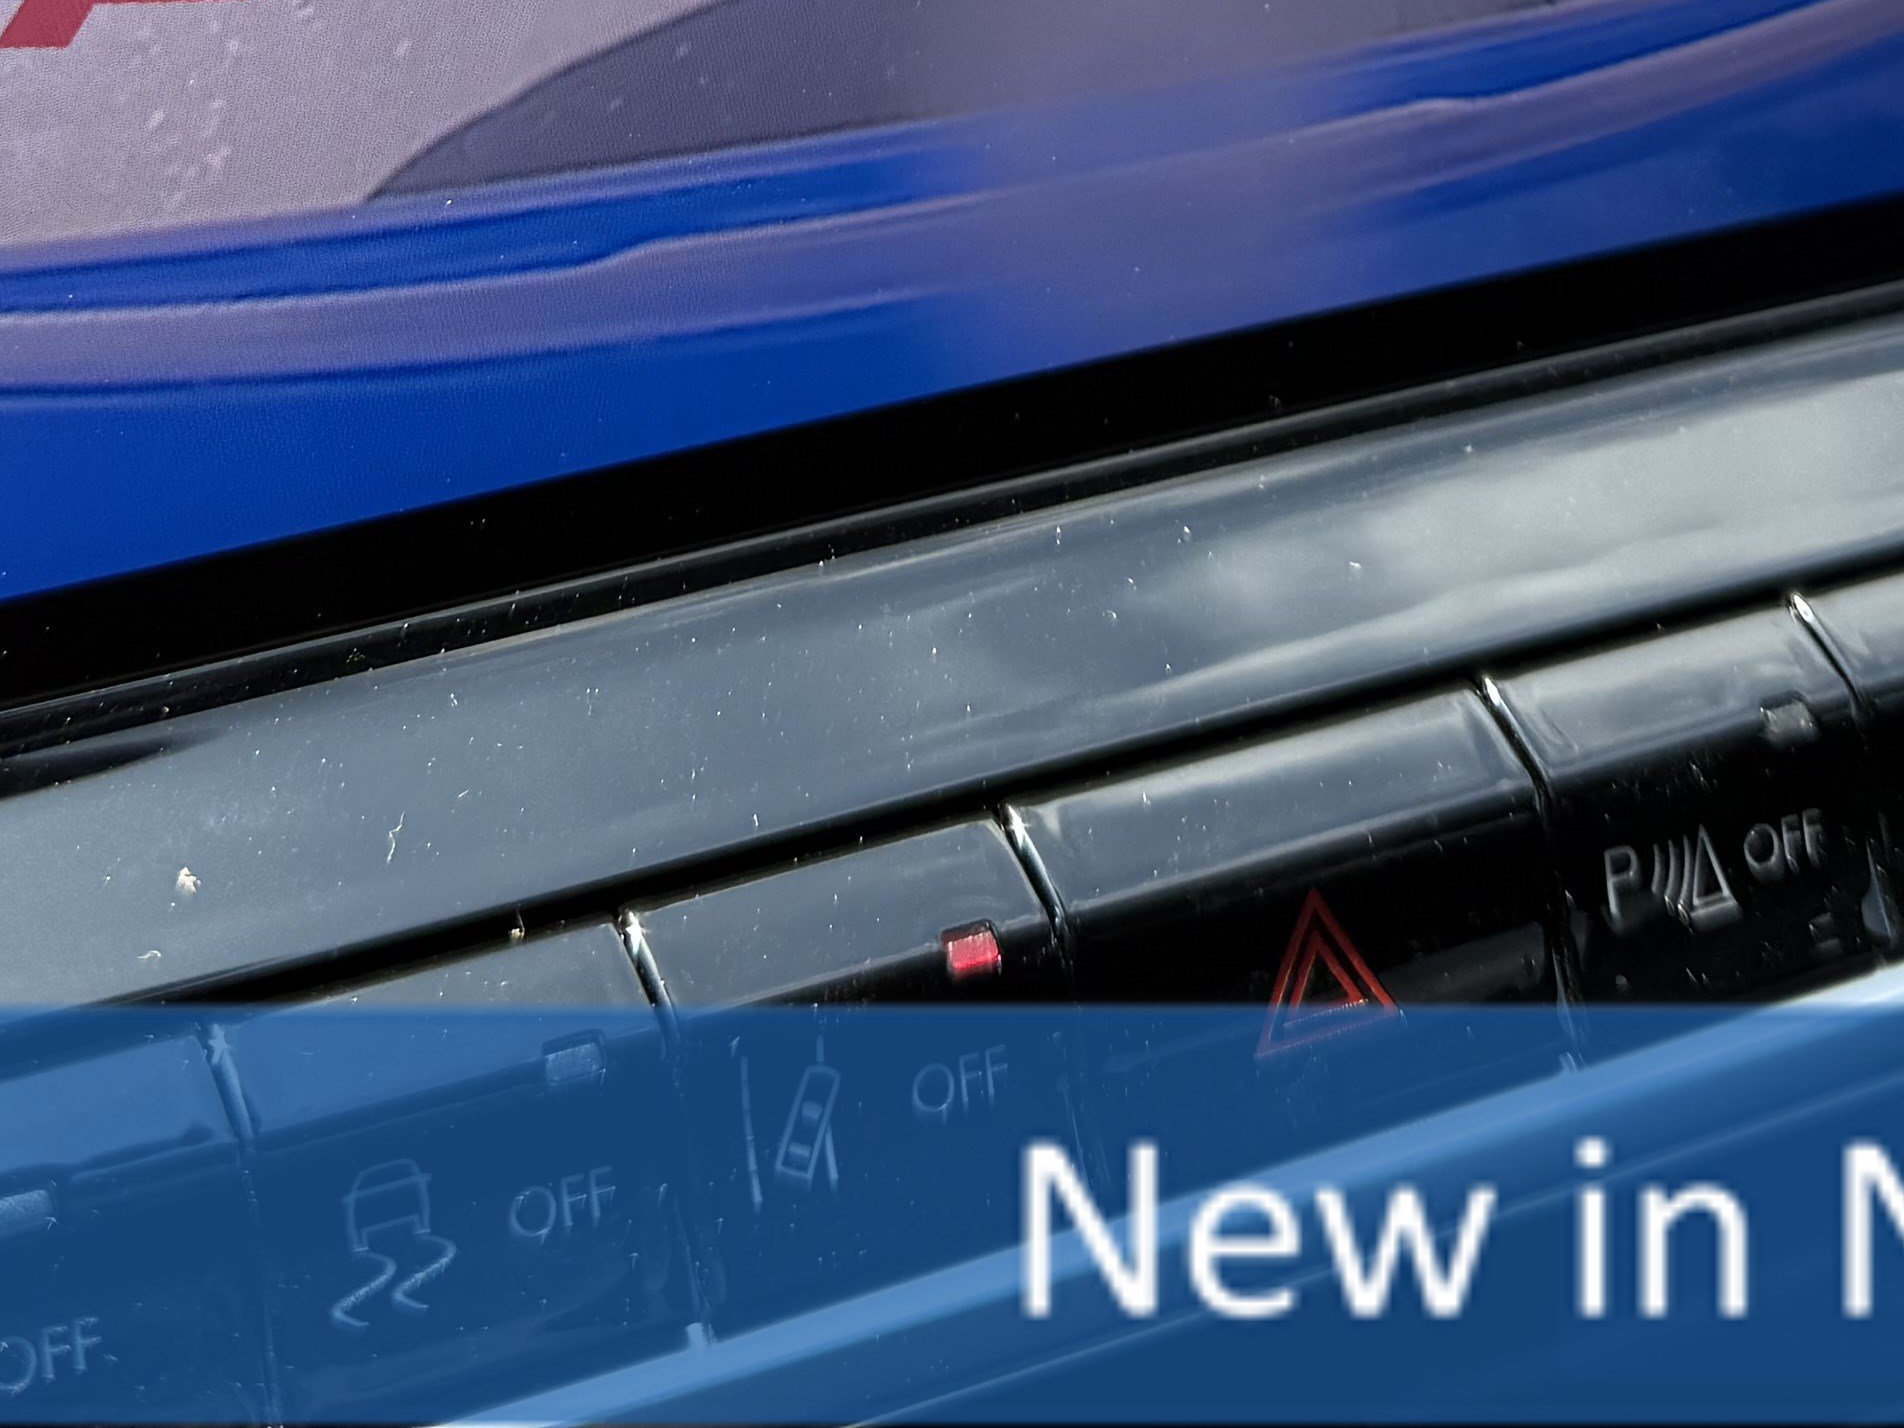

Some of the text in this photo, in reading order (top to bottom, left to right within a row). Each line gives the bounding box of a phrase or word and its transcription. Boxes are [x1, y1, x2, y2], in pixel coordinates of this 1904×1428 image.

[1743, 807, 1827, 876] OFF
[912, 1043, 1009, 1112] OFF
[509, 1164, 616, 1238] OFF
